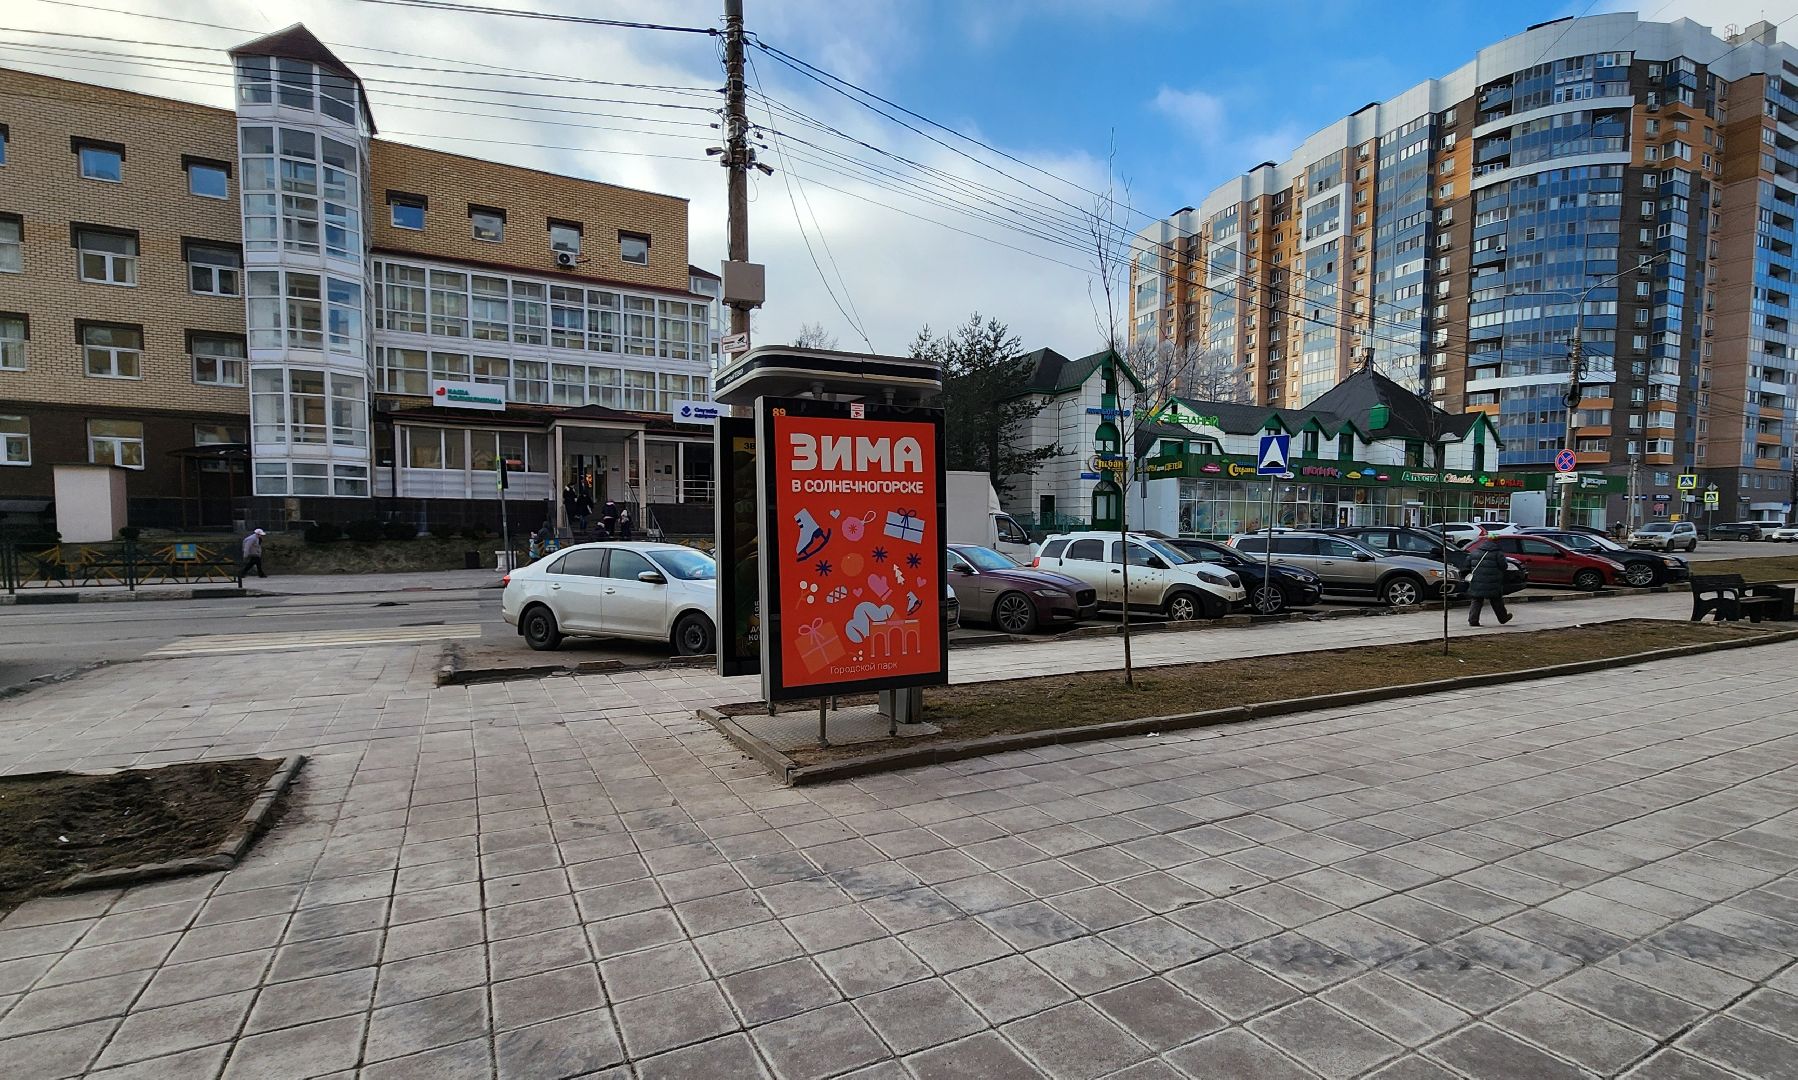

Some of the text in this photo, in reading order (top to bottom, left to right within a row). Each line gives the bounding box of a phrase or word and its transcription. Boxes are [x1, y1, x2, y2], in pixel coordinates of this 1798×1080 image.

[772, 407, 786, 417] 89
[790, 433, 923, 473] ЗИМА
[791, 480, 924, 494] В СОЛНЕЧНОГОРСКЕ
[1473, 495, 1510, 506] ЛОМБАРД
[830, 661, 898, 675] Городской парк
